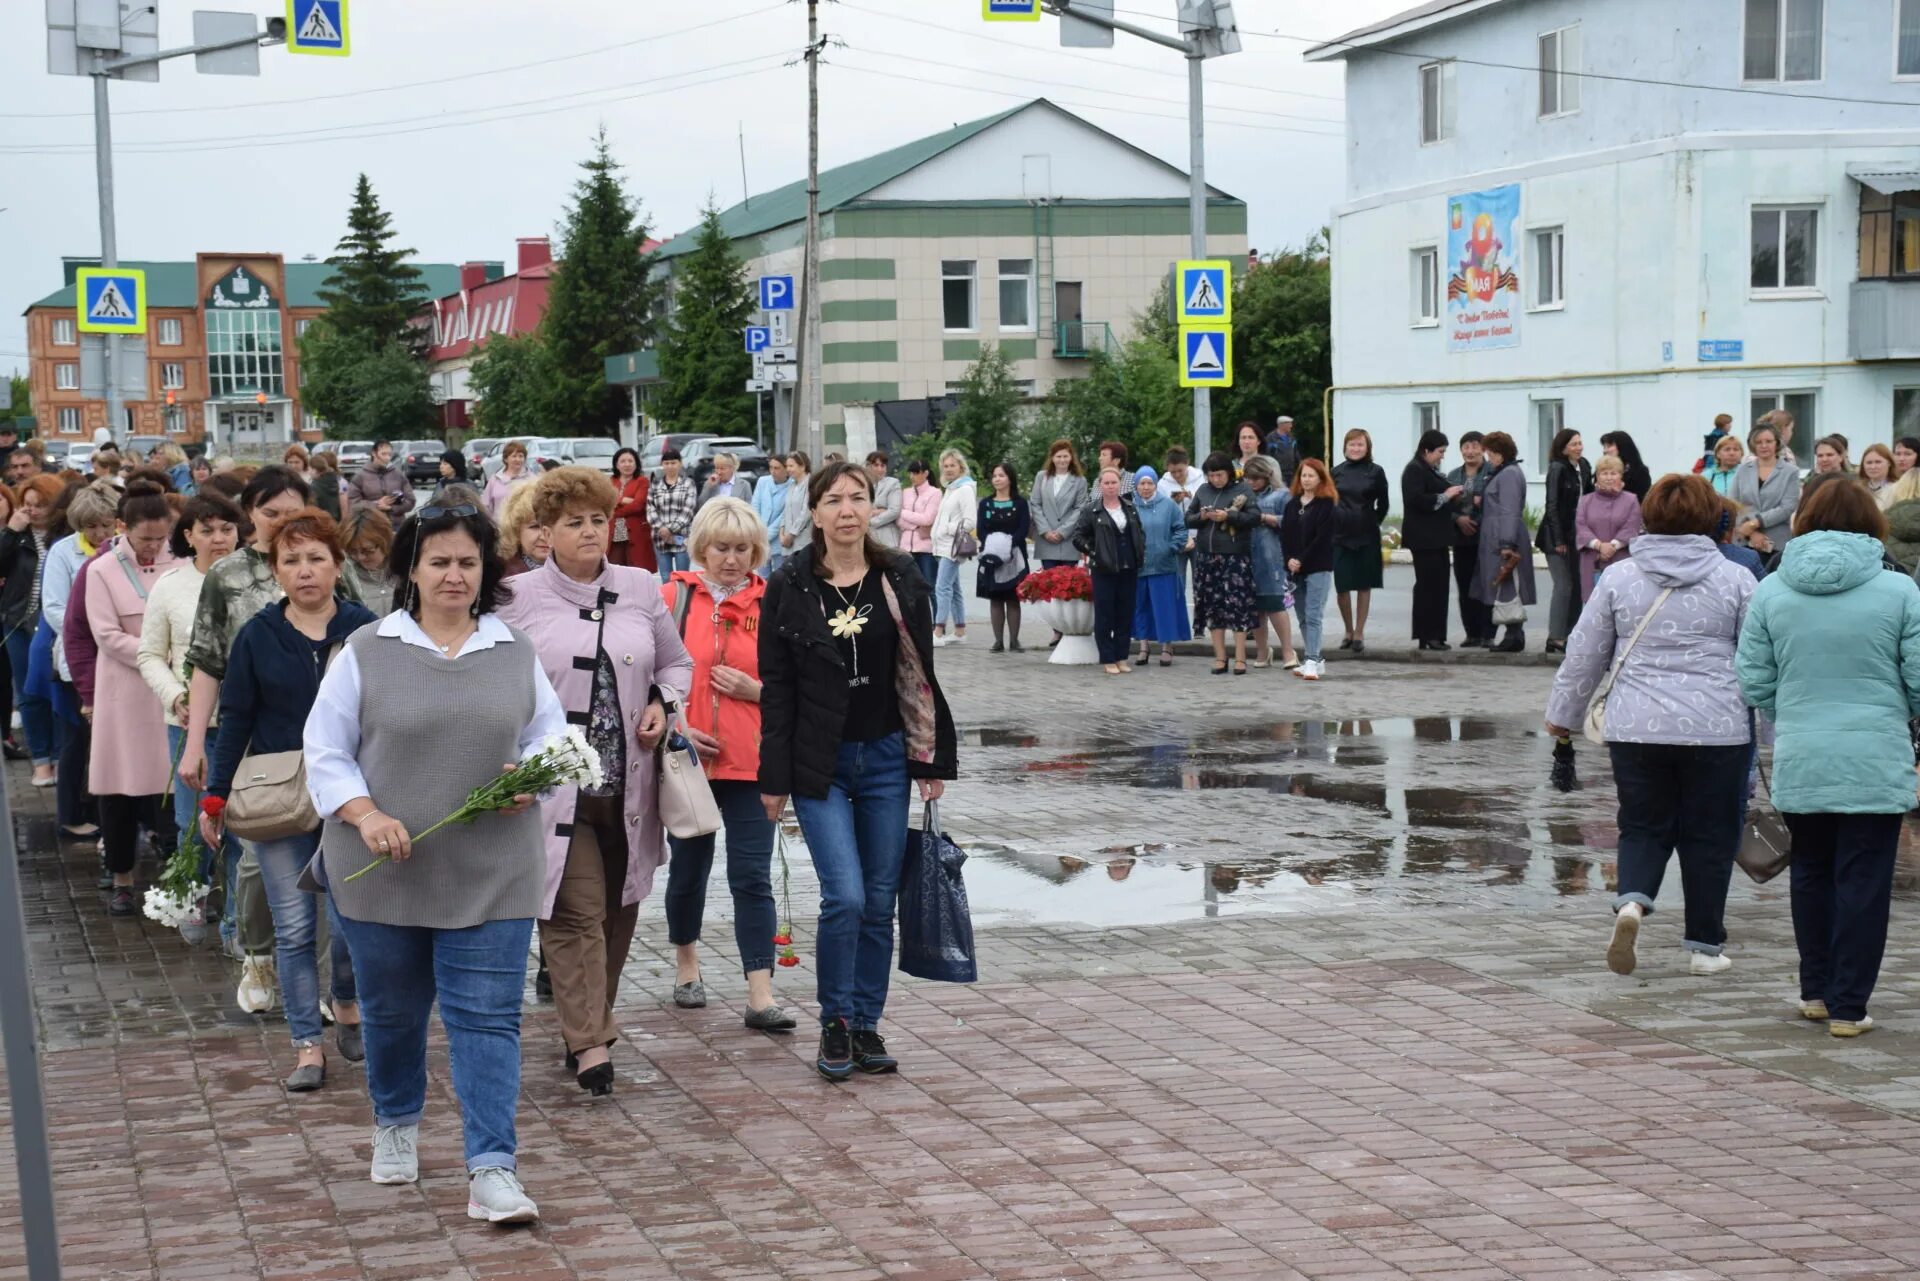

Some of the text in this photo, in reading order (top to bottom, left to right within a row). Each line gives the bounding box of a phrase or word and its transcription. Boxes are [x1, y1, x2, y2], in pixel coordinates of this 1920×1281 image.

[767, 280, 787, 307] P
[751, 330, 766, 350] P
[861, 676, 870, 685] ME
